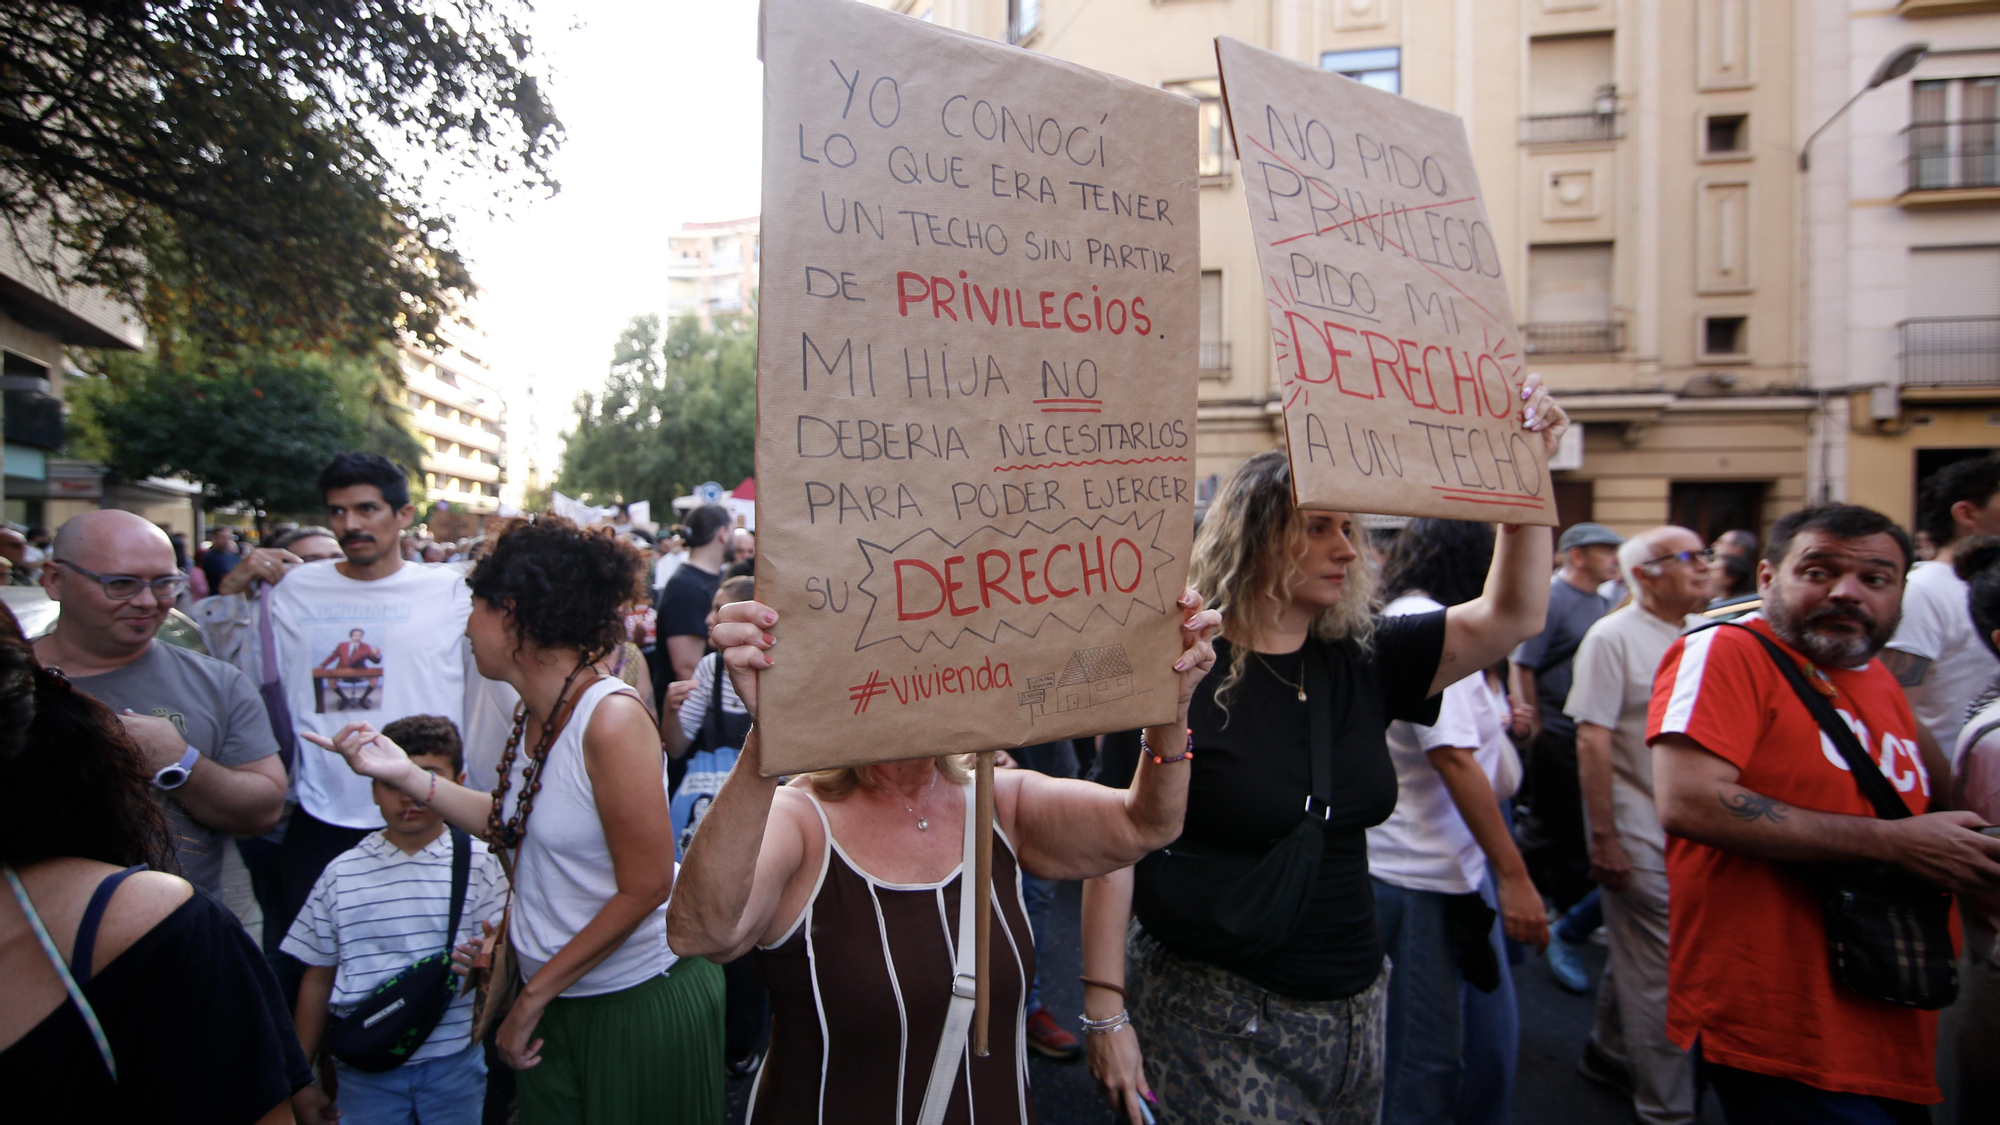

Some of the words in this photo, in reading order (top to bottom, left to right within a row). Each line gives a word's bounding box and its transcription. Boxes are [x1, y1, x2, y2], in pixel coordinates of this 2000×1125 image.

[829, 58, 900, 129] YO
[941, 94, 1108, 168] CONOCÍ
[1266, 104, 1336, 171] NO
[1355, 133, 1448, 198] PIDO
[799, 123, 858, 169] LO
[887, 145, 970, 190] QUE
[991, 163, 1058, 205] ERA
[1068, 180, 1175, 227] TENER
[821, 190, 885, 241] UN
[898, 210, 1009, 257] TECHO
[1257, 160, 1501, 279] PRIVILEGIO
[805, 265, 866, 302] DE
[1289, 252, 1377, 315] PIDO
[1404, 283, 1460, 335] MI
[802, 331, 877, 398] MI
[1041, 358, 1098, 399] NO
[1283, 310, 1512, 420] DERECHO
[797, 414, 971, 462] DEBERIA
[999, 419, 1188, 459] NECESITARLOS
[1306, 412, 1336, 468] A
[1343, 421, 1404, 478] UN
[1408, 419, 1543, 498] TECHO
[804, 481, 924, 525] PARA
[951, 480, 1066, 520] PODER
[1082, 475, 1189, 510] EJERCER
[805, 576, 850, 614] SU
[893, 534, 1143, 622] DERECHO
[848, 654, 1013, 716] #vivienda
